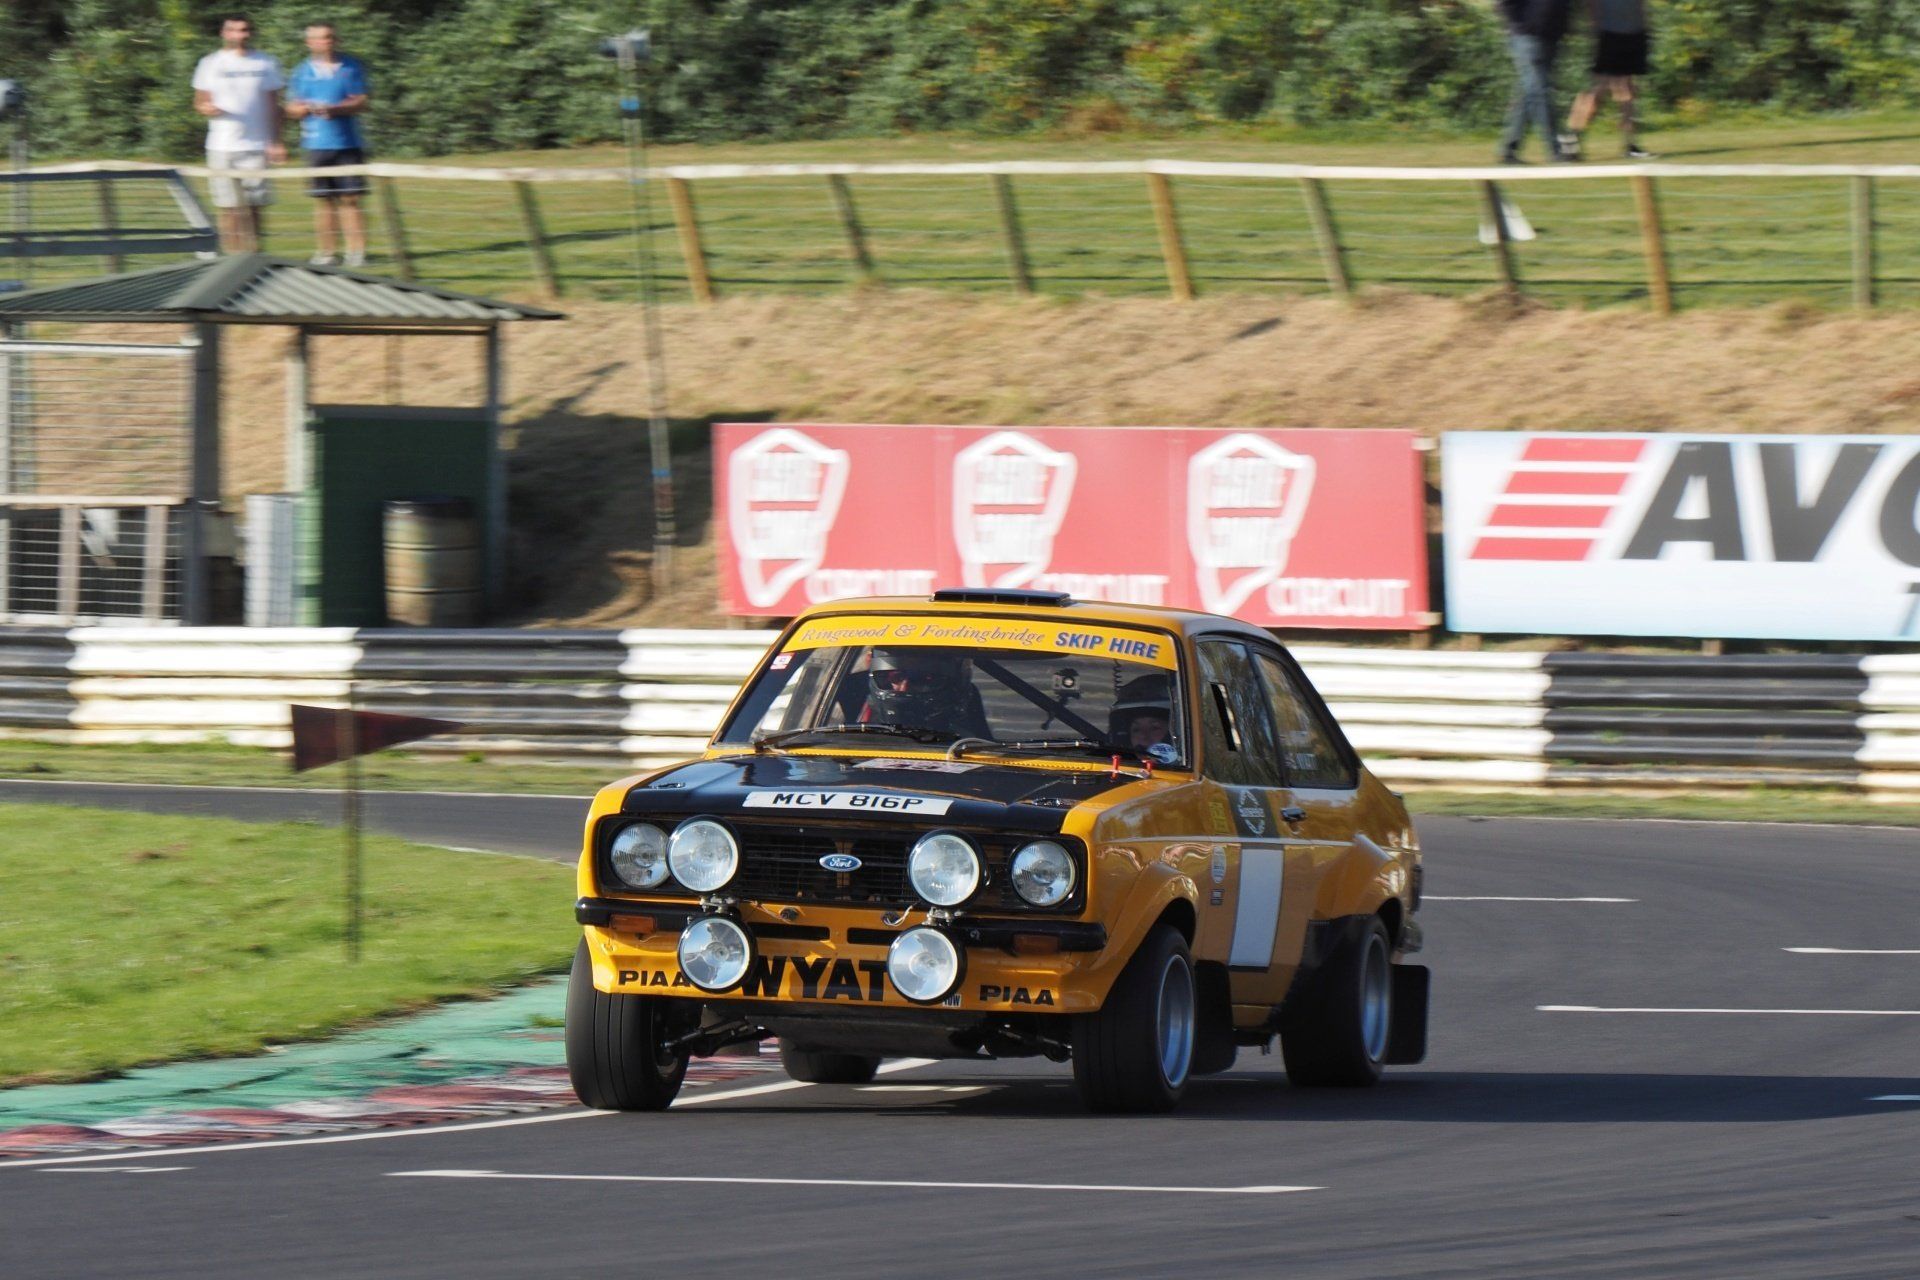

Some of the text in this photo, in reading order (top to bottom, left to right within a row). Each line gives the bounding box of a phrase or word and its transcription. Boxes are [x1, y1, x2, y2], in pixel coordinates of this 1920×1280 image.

[1266, 578, 1410, 617] CIRCUIT
[801, 624, 1160, 659] Ringwood & Fordingbridge SKIP HIRE
[772, 793, 923, 810] MCV 816P
[618, 970, 692, 987] PIAA
[980, 984, 1055, 1006] PIAA
